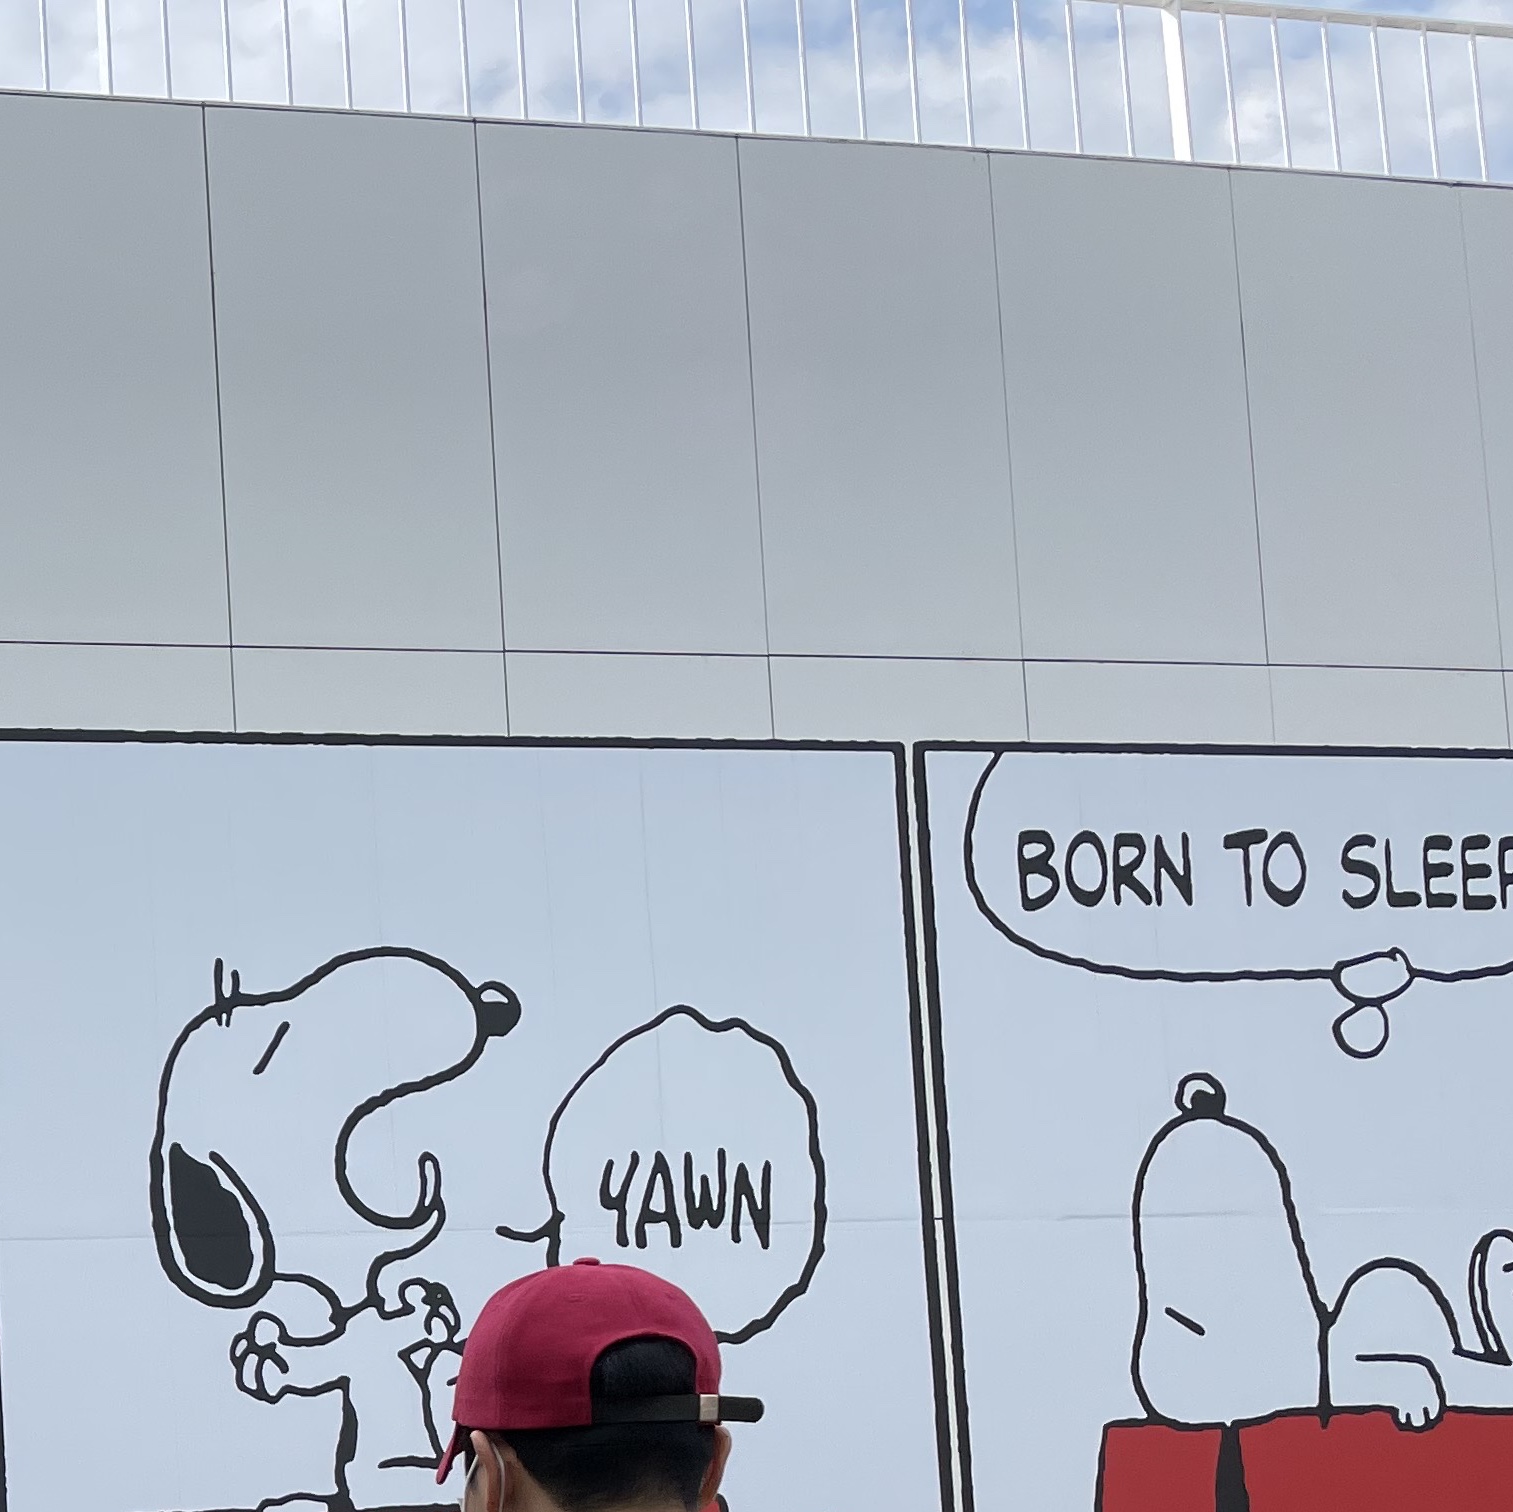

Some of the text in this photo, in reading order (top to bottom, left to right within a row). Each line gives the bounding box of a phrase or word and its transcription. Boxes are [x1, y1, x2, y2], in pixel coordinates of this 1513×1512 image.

[1018, 829, 1194, 912] BORN
[1223, 828, 1307, 908] TO
[599, 1147, 772, 1250] YAWN
